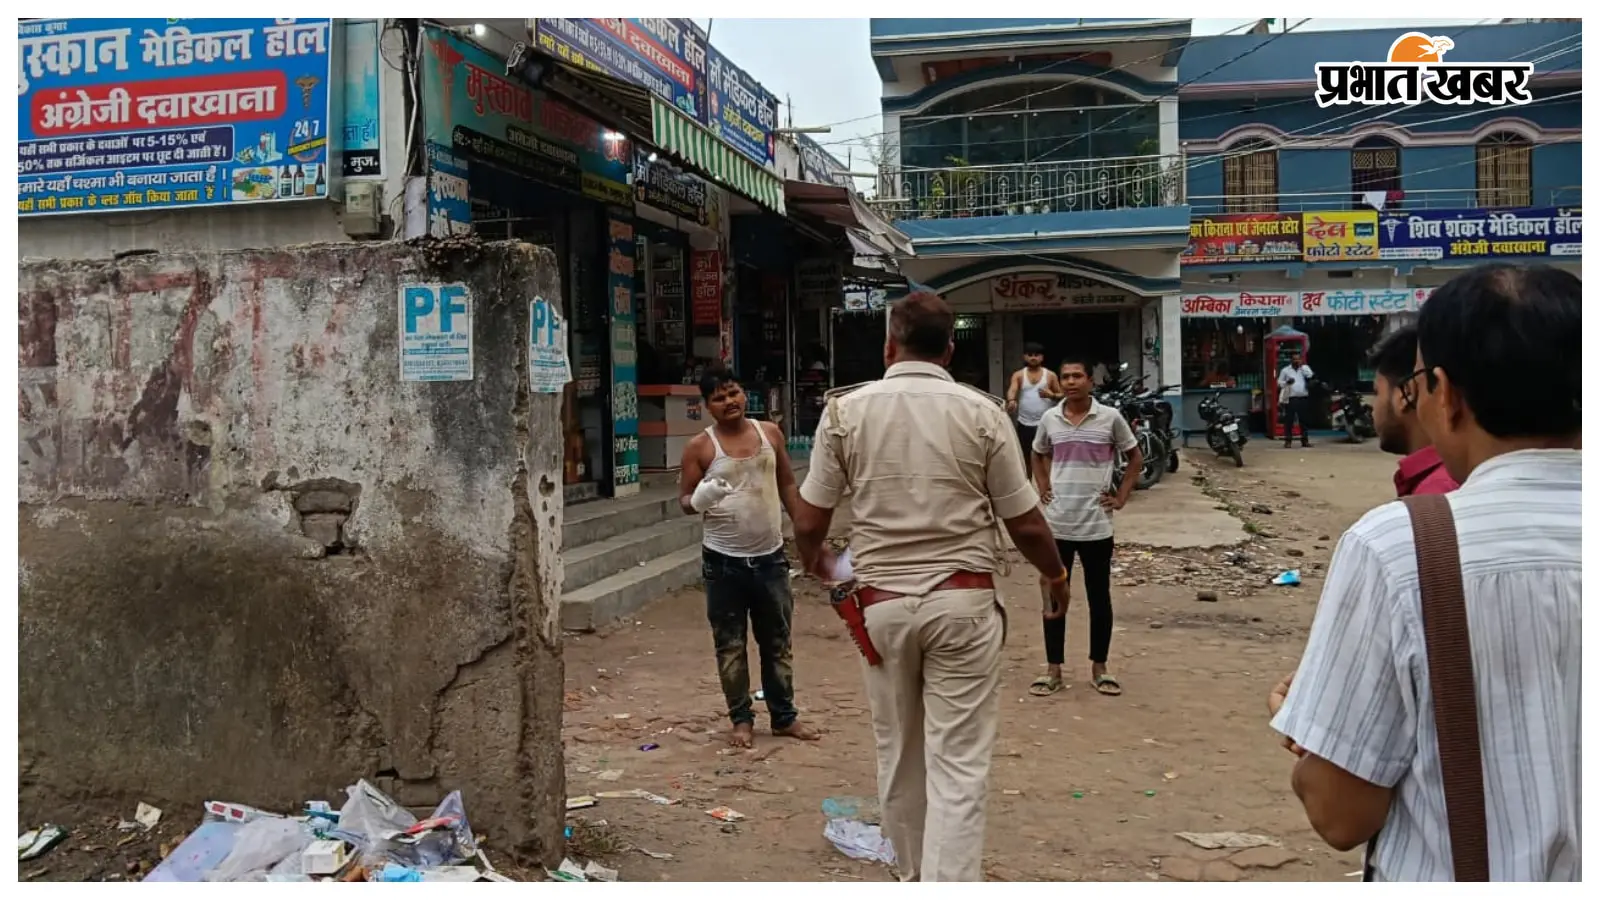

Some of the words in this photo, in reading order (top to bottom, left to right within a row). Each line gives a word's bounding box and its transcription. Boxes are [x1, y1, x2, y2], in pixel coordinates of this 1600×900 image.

[139, 26, 254, 67] मेडिकल
[40, 87, 131, 130] अंग्रेजी
[137, 86, 278, 124] दवाखाना
[132, 137, 146, 148] पर
[147, 133, 188, 148] 5-15%
[18, 159, 44, 174] 50%
[142, 152, 154, 162] पर
[173, 147, 185, 160] दी
[46, 175, 72, 192] यहाँ
[108, 171, 124, 187] भी
[127, 174, 167, 186] बनाया
[169, 170, 203, 183] जाता
[1203, 219, 1233, 238] किराना
[1235, 218, 1249, 236] एवं
[1281, 216, 1299, 234] स्टोर
[1408, 216, 1442, 239] शिव
[1445, 214, 1485, 238] शंकर
[1487, 213, 1550, 236] मेडिकल
[1306, 242, 1341, 257] फोटो
[1344, 242, 1374, 257] स्टेट
[1450, 239, 1489, 256] अंग्रेजी
[1492, 240, 1546, 254] दवाखाना
[405, 286, 466, 333] PF
[1181, 295, 1233, 314] अम्बिका
[1239, 293, 1287, 306] किराना
[1327, 289, 1366, 311] फोटो
[1368, 290, 1408, 311] स्टेट
